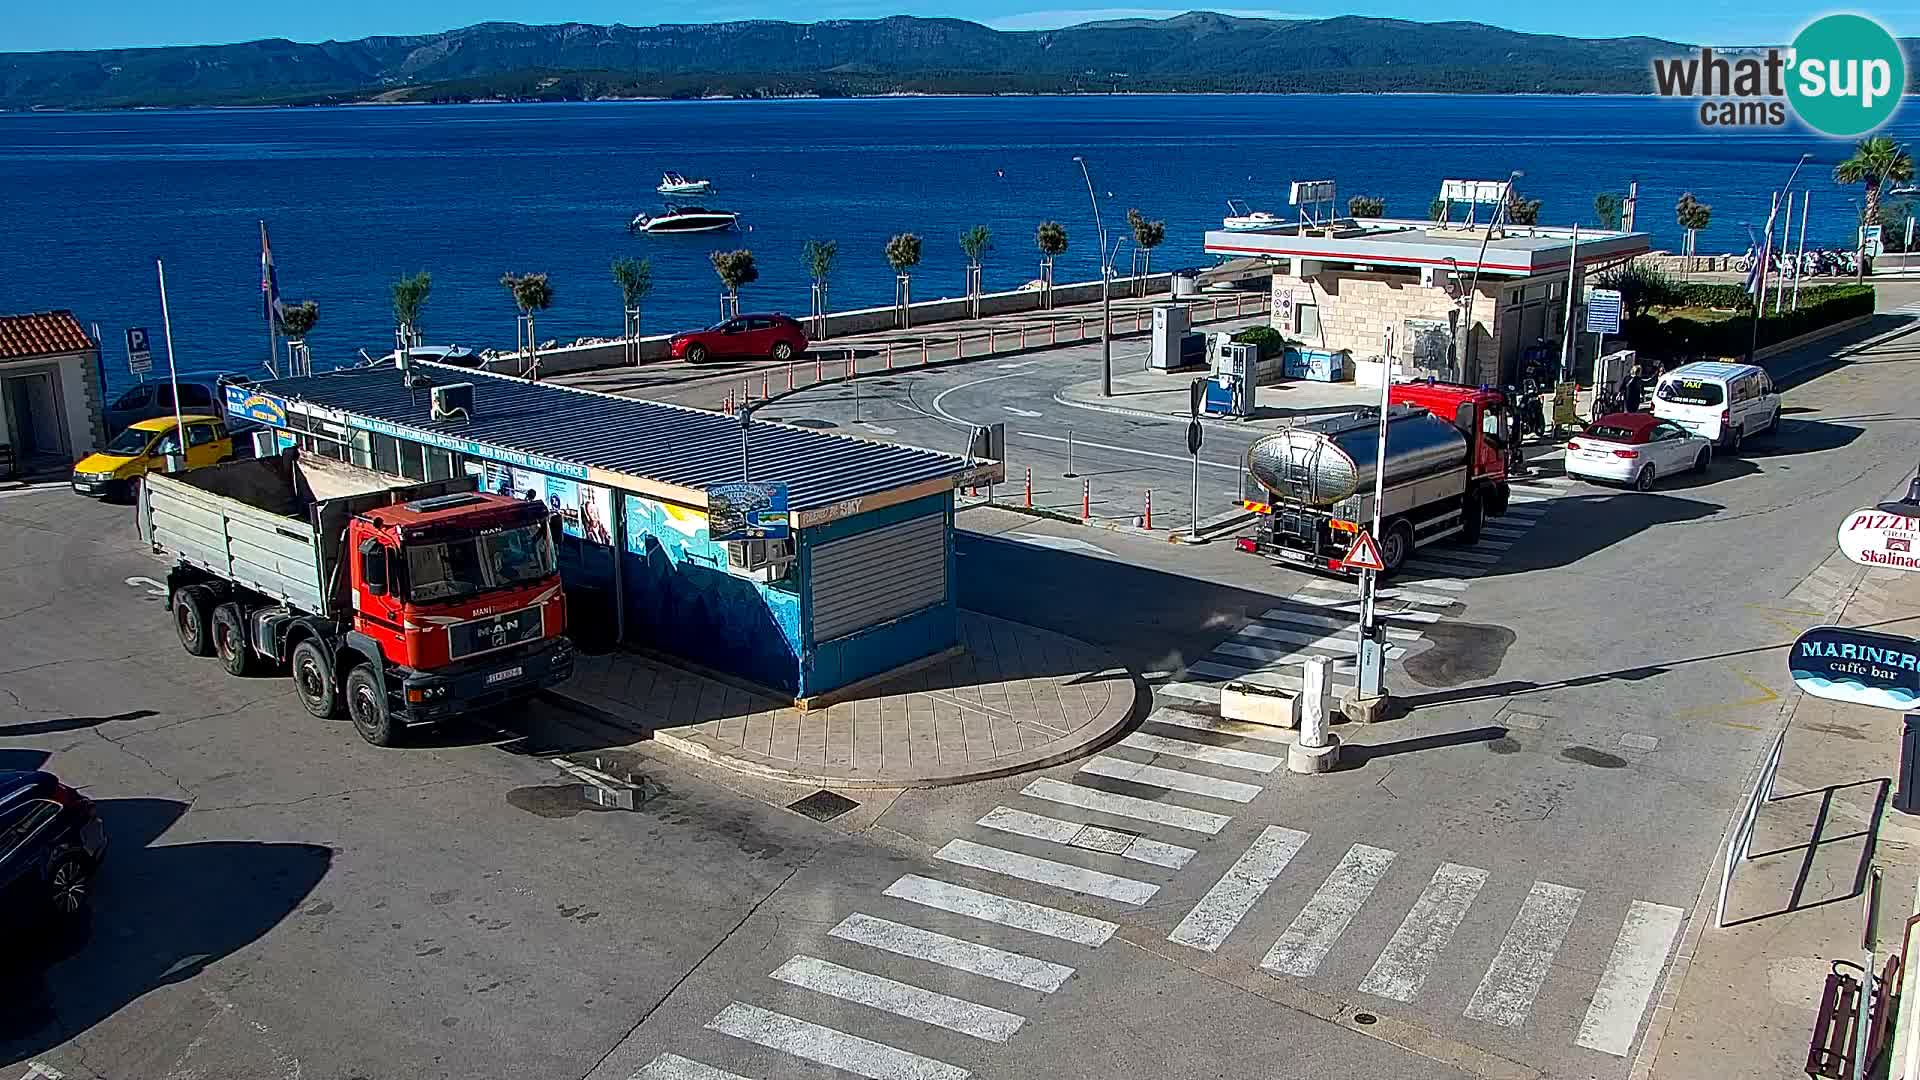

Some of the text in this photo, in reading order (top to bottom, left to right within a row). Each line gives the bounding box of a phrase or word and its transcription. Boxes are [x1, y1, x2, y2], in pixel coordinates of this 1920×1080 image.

[131, 331, 144, 349] P
[1682, 380, 1702, 389] TAXI
[437, 435, 469, 451] POSTAJA
[480, 446, 494, 459] BUS
[494, 449, 528, 464] STATION
[530, 456, 556, 471] TICKET
[556, 463, 584, 477] OFFICE
[840, 499, 864, 514] SKY
[1849, 515, 1918, 531] PIZZE
[480, 527, 503, 536] MAN
[472, 607, 489, 617] MAN
[1830, 661, 1899, 681] caffe bar
